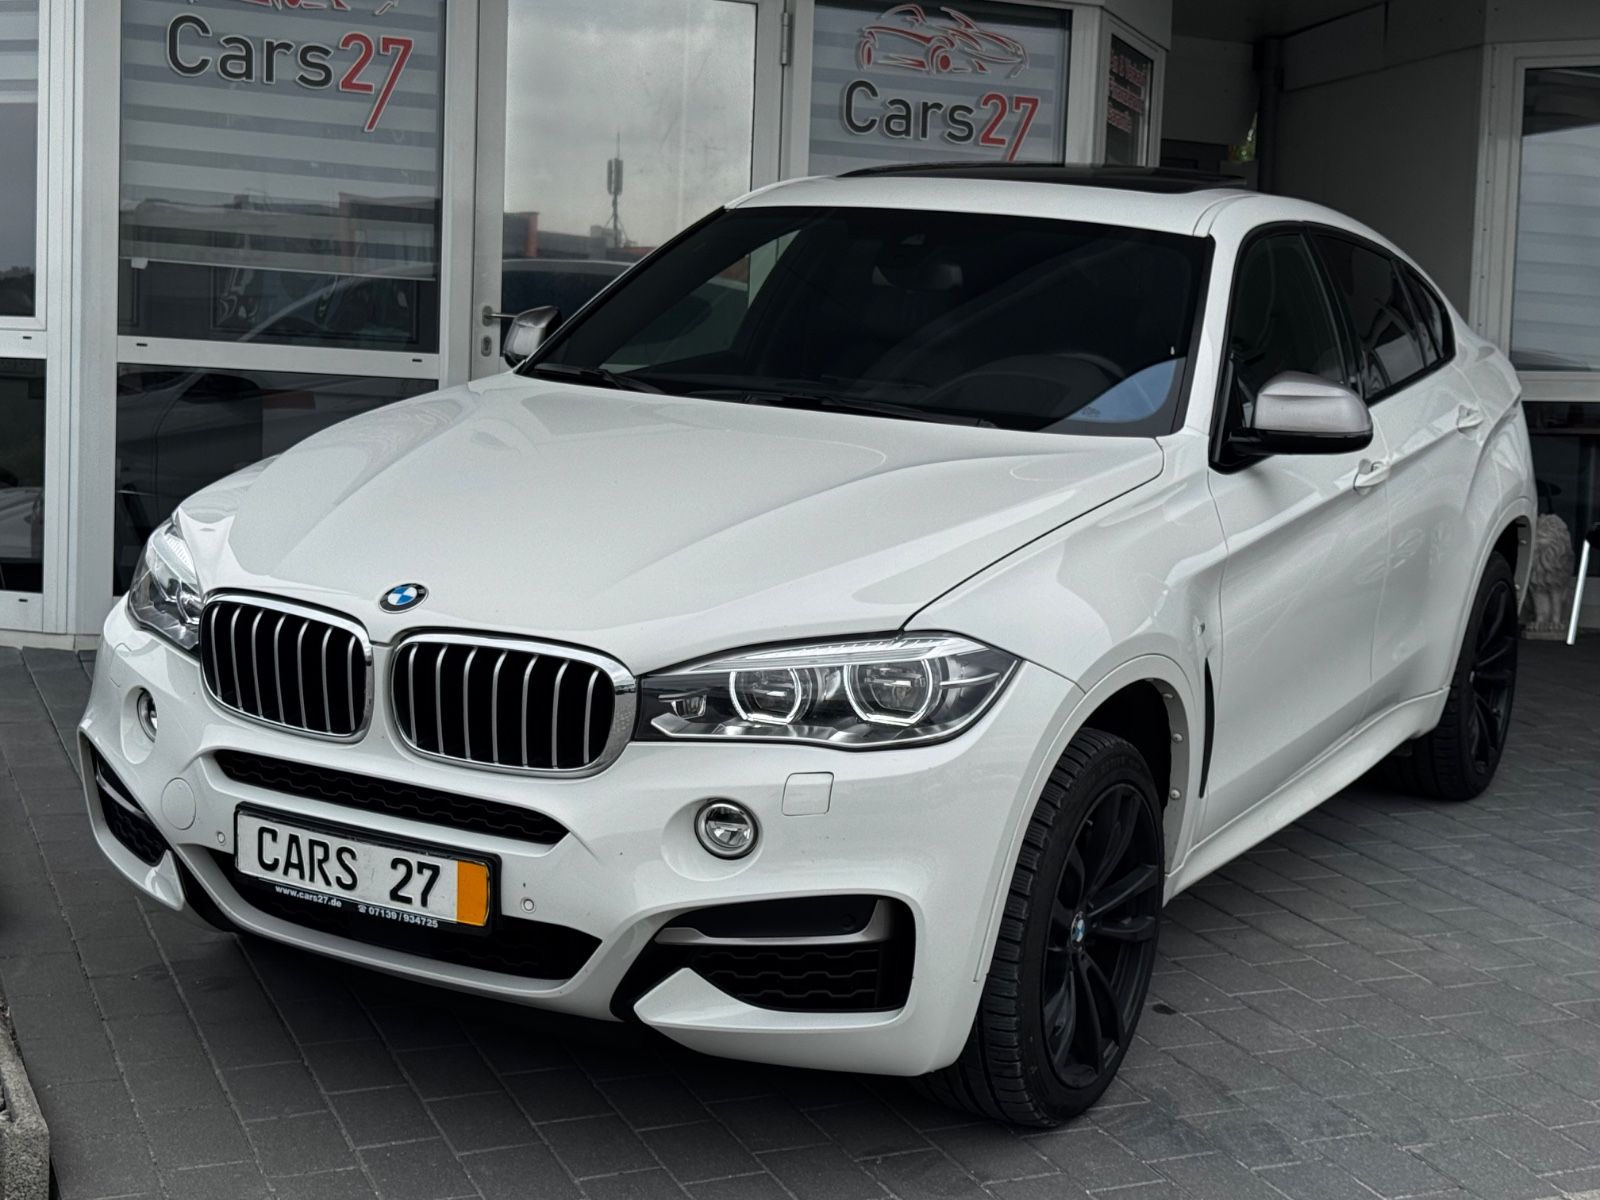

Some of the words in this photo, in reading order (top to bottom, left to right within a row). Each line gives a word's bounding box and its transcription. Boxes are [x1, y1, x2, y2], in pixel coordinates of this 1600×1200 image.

[167, 13, 413, 132] Cars27
[843, 79, 1041, 162] Cars27
[257, 826, 359, 891] CARS
[389, 857, 442, 908] 27
[275, 885, 342, 908] www.cars27.de
